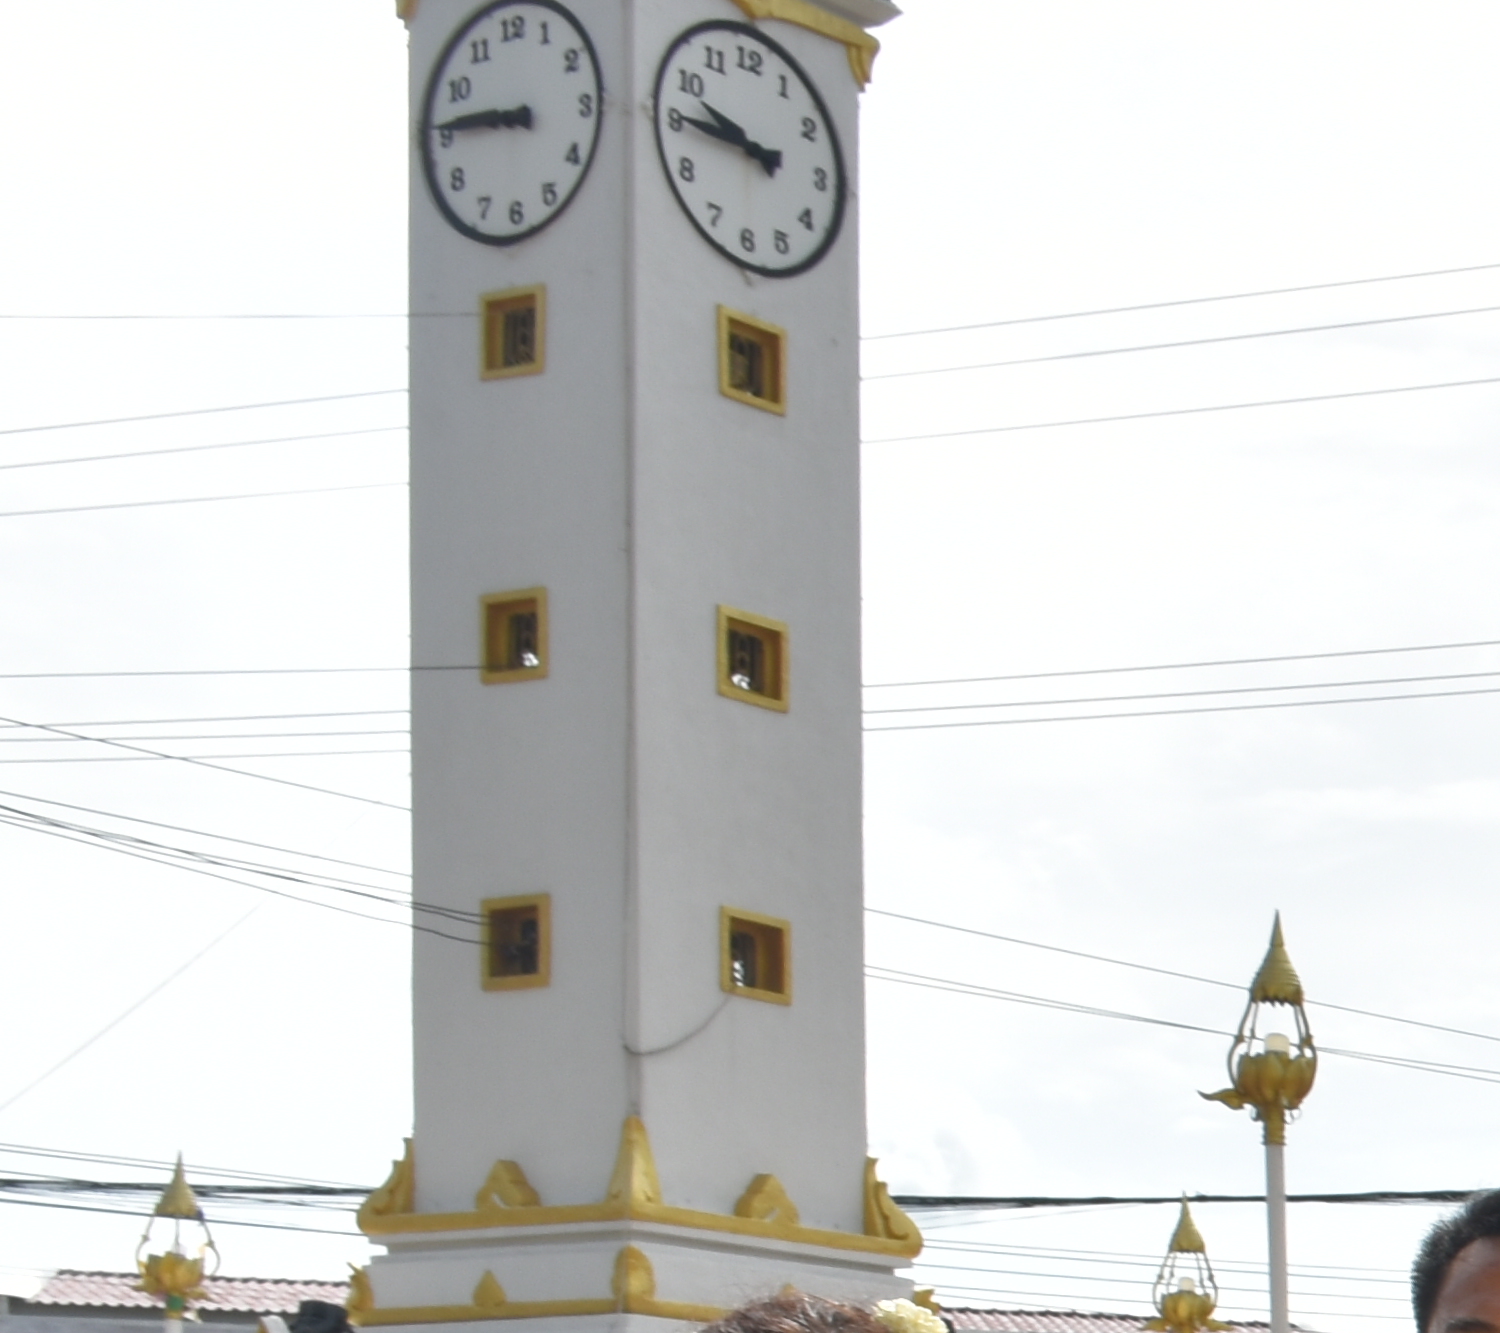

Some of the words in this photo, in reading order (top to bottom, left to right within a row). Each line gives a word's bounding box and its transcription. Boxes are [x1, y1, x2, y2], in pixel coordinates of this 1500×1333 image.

[500, 15, 525, 43] 12
[539, 21, 551, 45] 1
[470, 38, 490, 64] 11
[563, 48, 579, 73] 2
[704, 45, 726, 76] 11
[736, 45, 763, 77] 12
[448, 76, 471, 103] 10
[678, 68, 704, 98] 10
[778, 74, 789, 99] 1
[578, 93, 593, 118] 3
[801, 117, 817, 142] 2
[564, 142, 580, 166] 4
[450, 167, 465, 192] 8
[679, 155, 695, 183] 8
[813, 167, 828, 192] 3
[541, 182, 557, 206] 5
[477, 196, 492, 220] 7
[508, 200, 524, 225] 6
[706, 201, 723, 227] 7
[797, 207, 814, 231] 4
[740, 228, 756, 253] 6
[773, 229, 789, 255] 5
